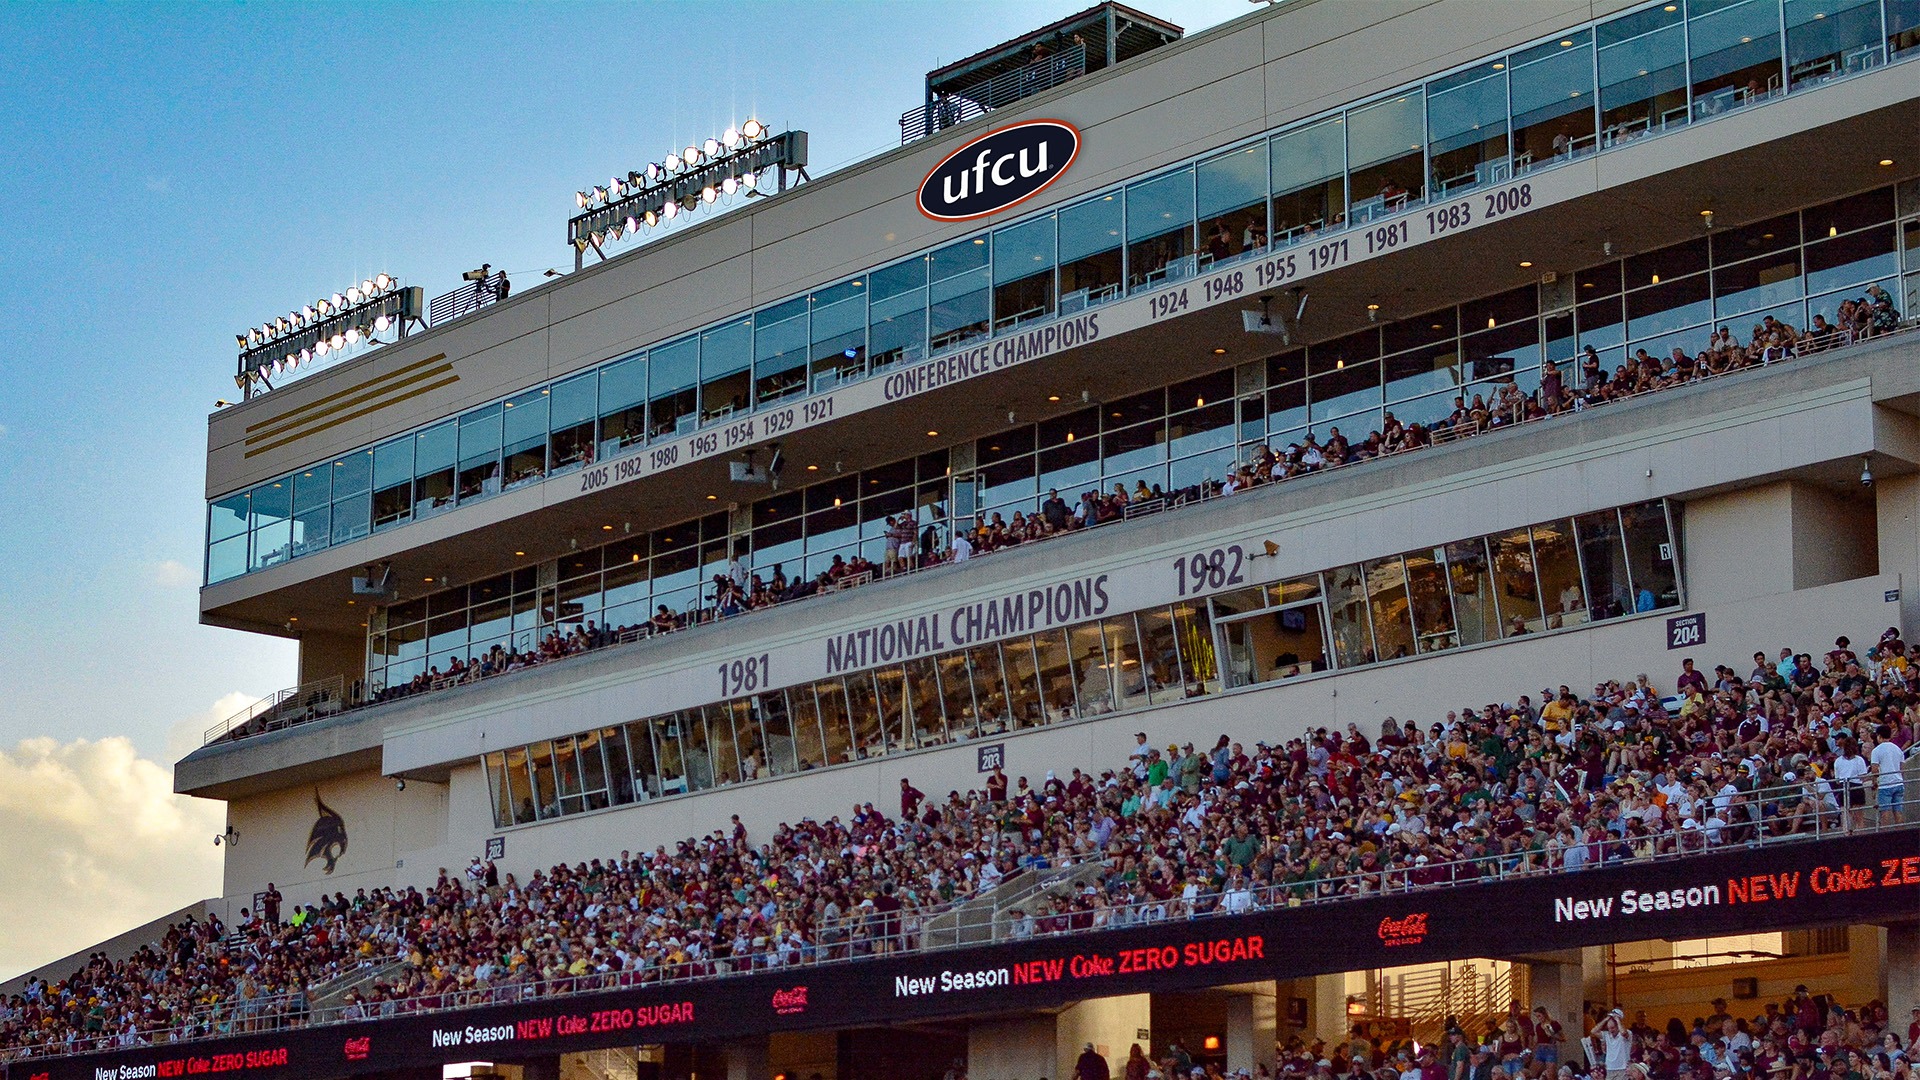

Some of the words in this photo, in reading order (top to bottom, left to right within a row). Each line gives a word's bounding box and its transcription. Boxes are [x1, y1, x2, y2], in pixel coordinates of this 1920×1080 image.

[943, 141, 1048, 204] ufcu
[581, 467, 608, 492] 2005
[614, 457, 642, 480] 1982
[650, 446, 678, 470] 1980
[689, 433, 717, 458] 1963
[724, 421, 754, 448] 1954
[763, 409, 794, 435] 1929
[803, 397, 834, 424] 1921
[884, 345, 989, 401] CONFERENCE
[993, 313, 1099, 368] CHAMPIONS
[1149, 288, 1189, 319] 1924
[1203, 271, 1244, 302] 1948
[1255, 254, 1297, 286] 1955
[1308, 238, 1349, 271] 1971
[1365, 220, 1408, 253] 1981
[1426, 201, 1471, 235] 1983
[1484, 183, 1532, 219] 2008
[1662, 545, 1669, 559] R
[718, 653, 769, 697] 1981
[826, 613, 944, 674] NATIONAL
[950, 574, 1108, 646] CHAMPIONS
[1174, 545, 1244, 597] 1982
[1673, 625, 1700, 646] 204
[1675, 617, 1697, 627] SECTION
[1554, 897, 1613, 923] New
[1620, 884, 1720, 915] Season
[1727, 871, 1801, 904] NEW
[1809, 864, 1876, 894] Coke
[895, 975, 937, 997] New
[941, 968, 1009, 992] Season
[1013, 958, 1065, 985] NEW
[1070, 954, 1115, 979] Coke
[1118, 945, 1179, 974] ZERO
[1183, 935, 1265, 967] SUGAR
[432, 1029, 462, 1048] New
[465, 1025, 514, 1044] Season
[517, 1017, 553, 1039] NEW
[557, 1014, 588, 1035] Coke
[590, 1009, 634, 1032] ZERO
[637, 1001, 695, 1027] SUGAR
[95, 1067, 118, 1080] New
[119, 1064, 156, 1080] Season
[157, 1059, 185, 1078] NEW
[212, 1053, 244, 1072] ZERO
[246, 1048, 288, 1069] SUGAR
